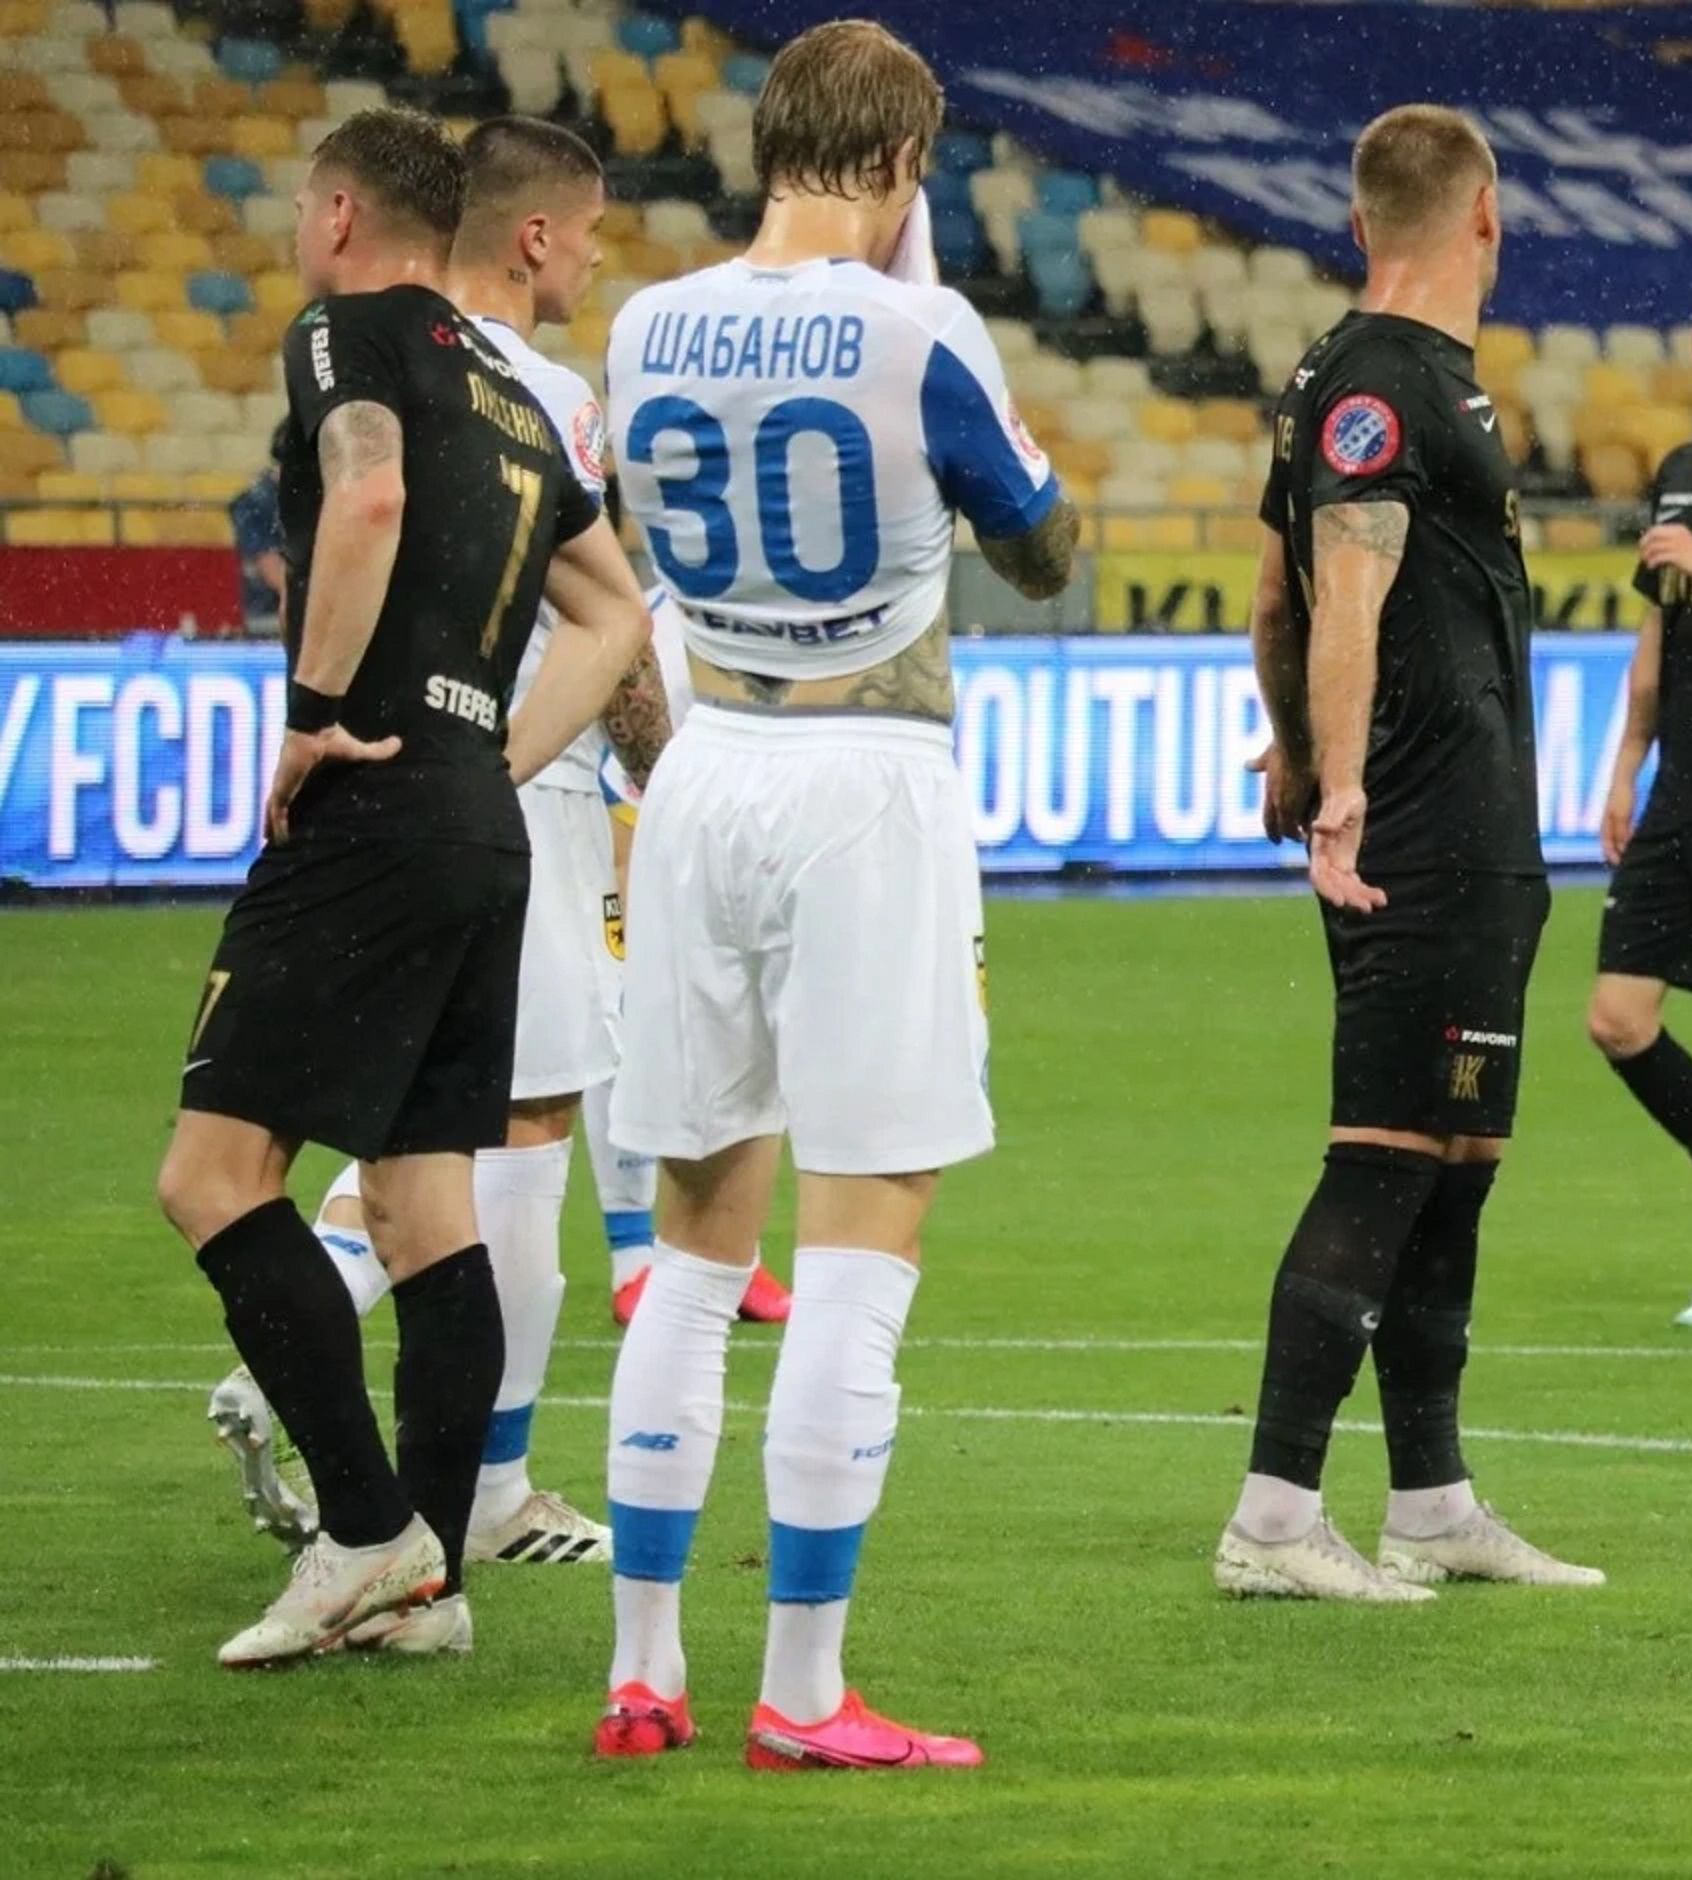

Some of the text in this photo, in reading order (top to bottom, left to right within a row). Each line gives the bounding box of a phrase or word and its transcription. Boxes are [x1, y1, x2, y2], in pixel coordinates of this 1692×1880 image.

[640, 311, 865, 380] ШАБАНОВ
[480, 452, 543, 659] 7
[627, 394, 880, 604] 30
